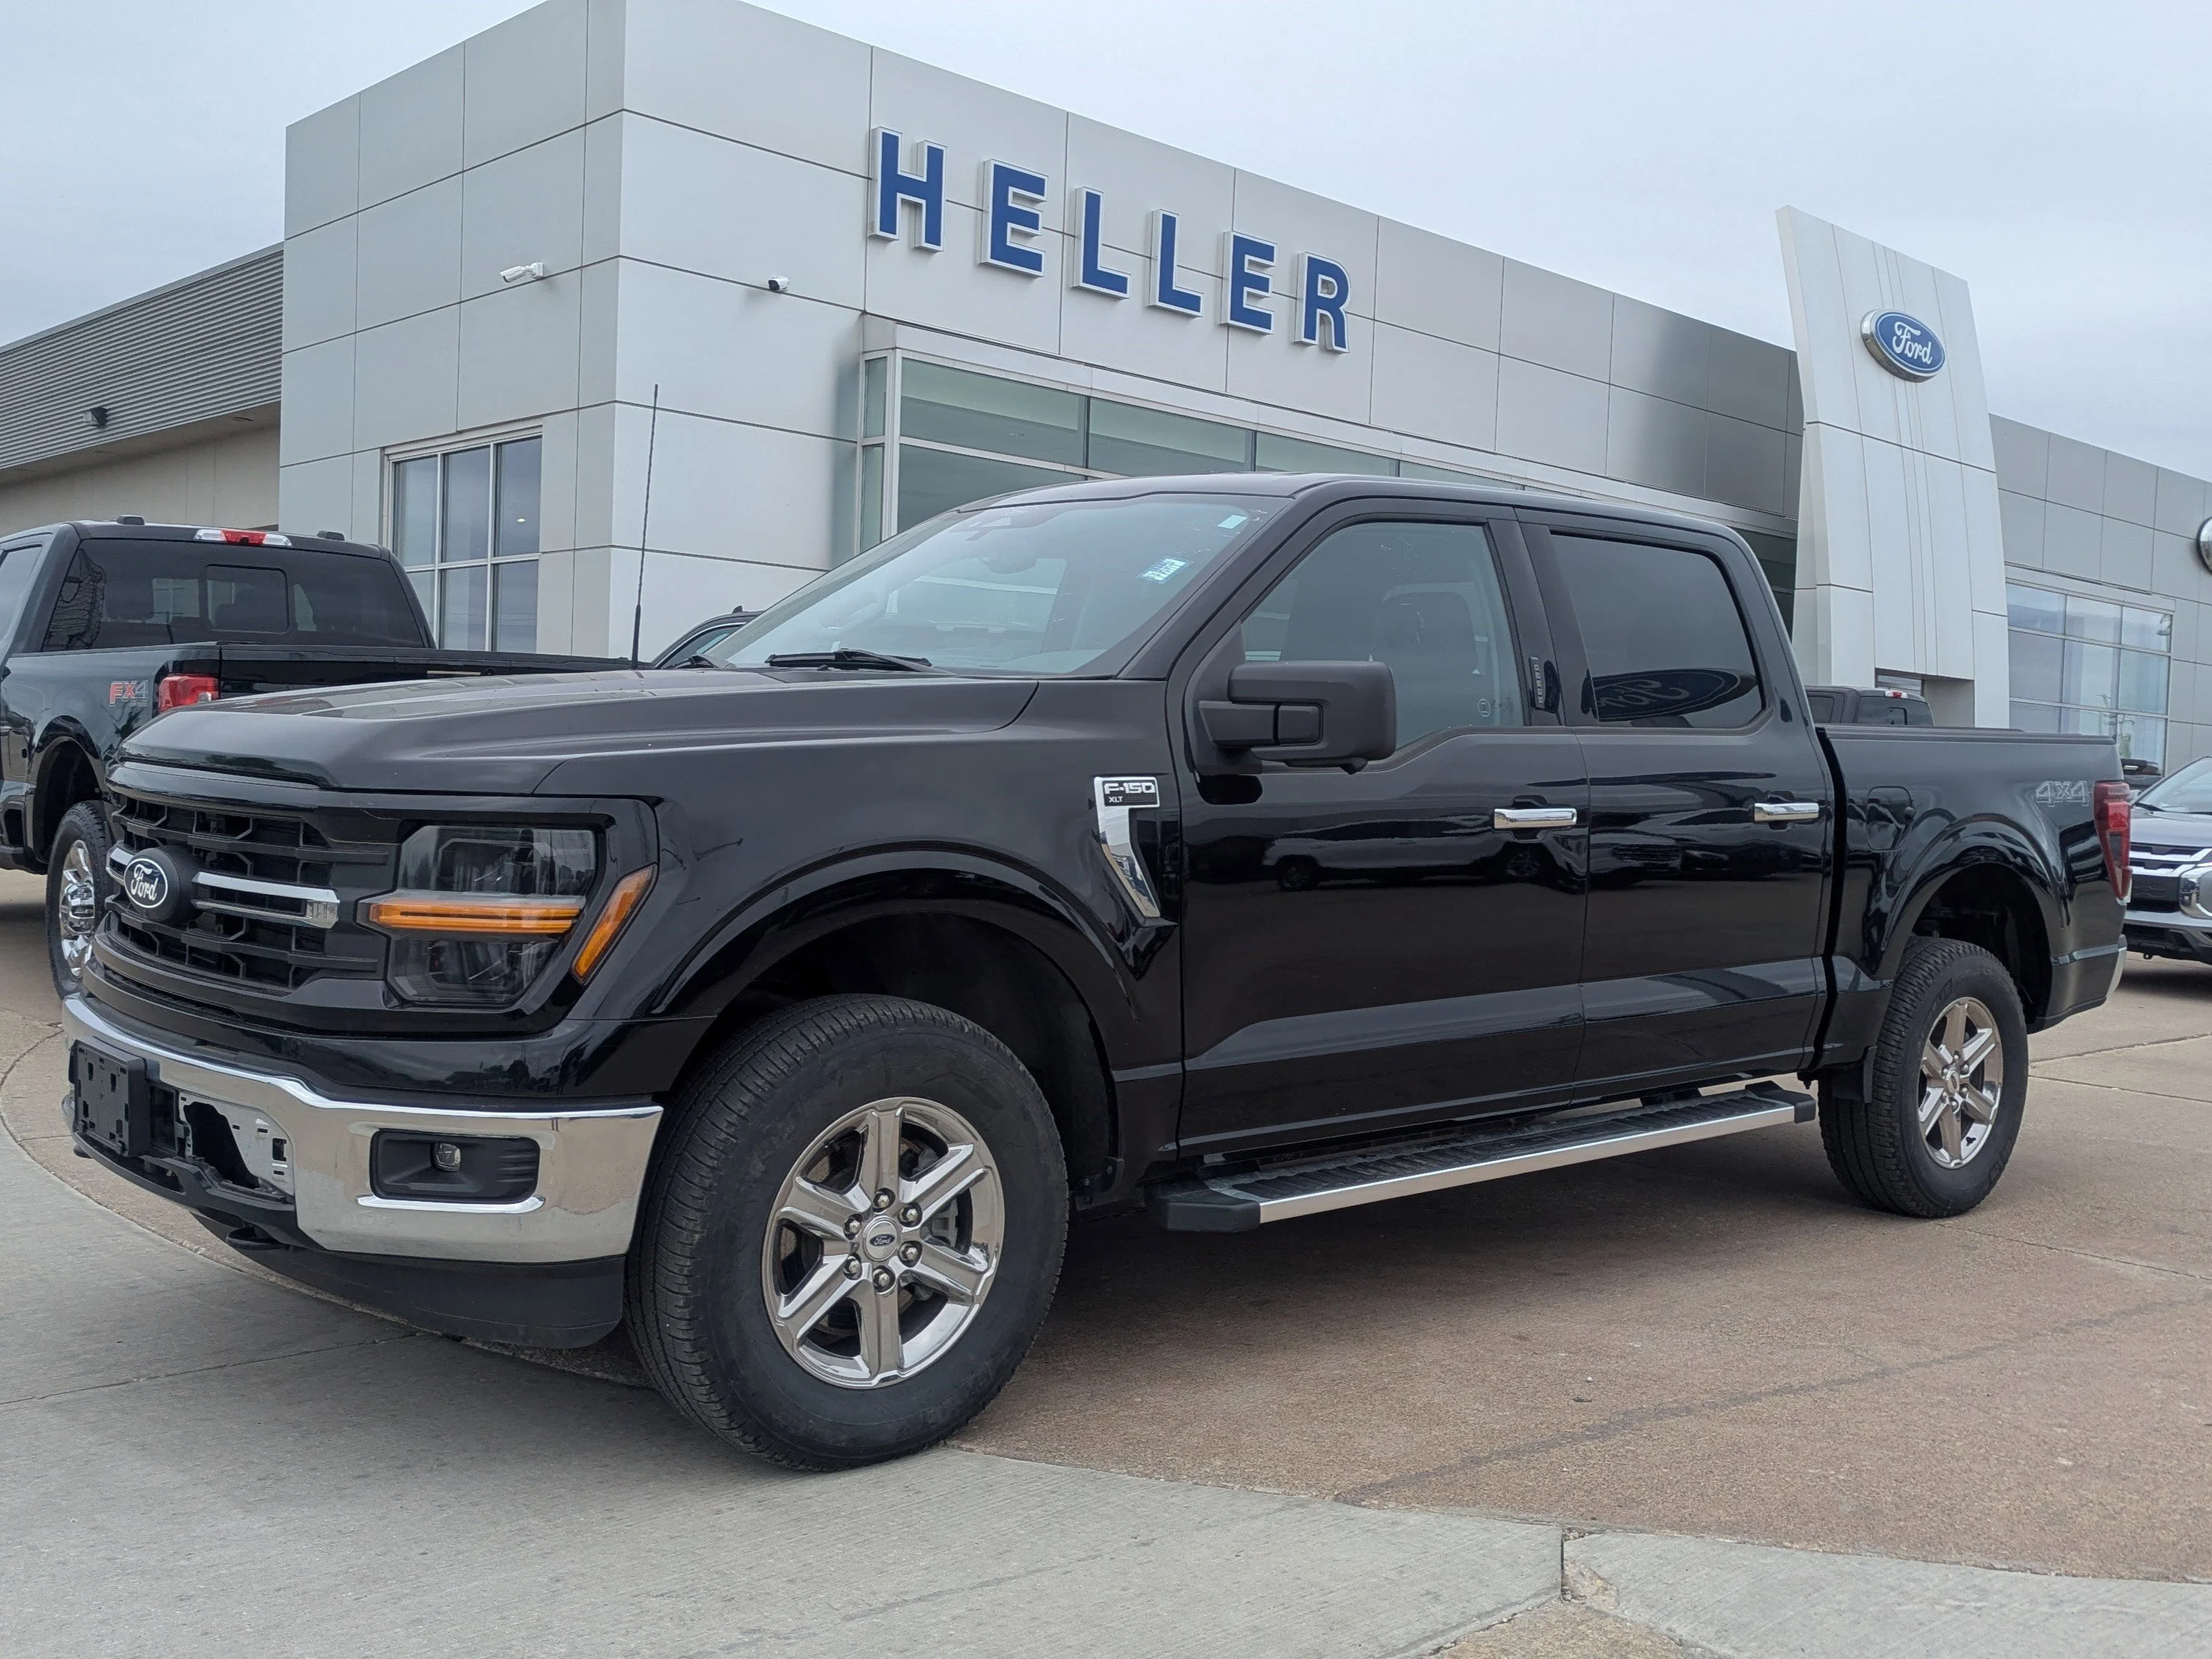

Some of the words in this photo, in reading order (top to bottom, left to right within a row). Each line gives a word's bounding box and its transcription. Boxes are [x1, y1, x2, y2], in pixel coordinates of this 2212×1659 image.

[870, 127, 1350, 353] HELLER
[1892, 322, 1933, 364] Ford
[109, 679, 149, 707] FX4
[1104, 782, 1156, 794] F-150
[130, 863, 160, 901] Ford
[873, 1235, 892, 1246] Ford
